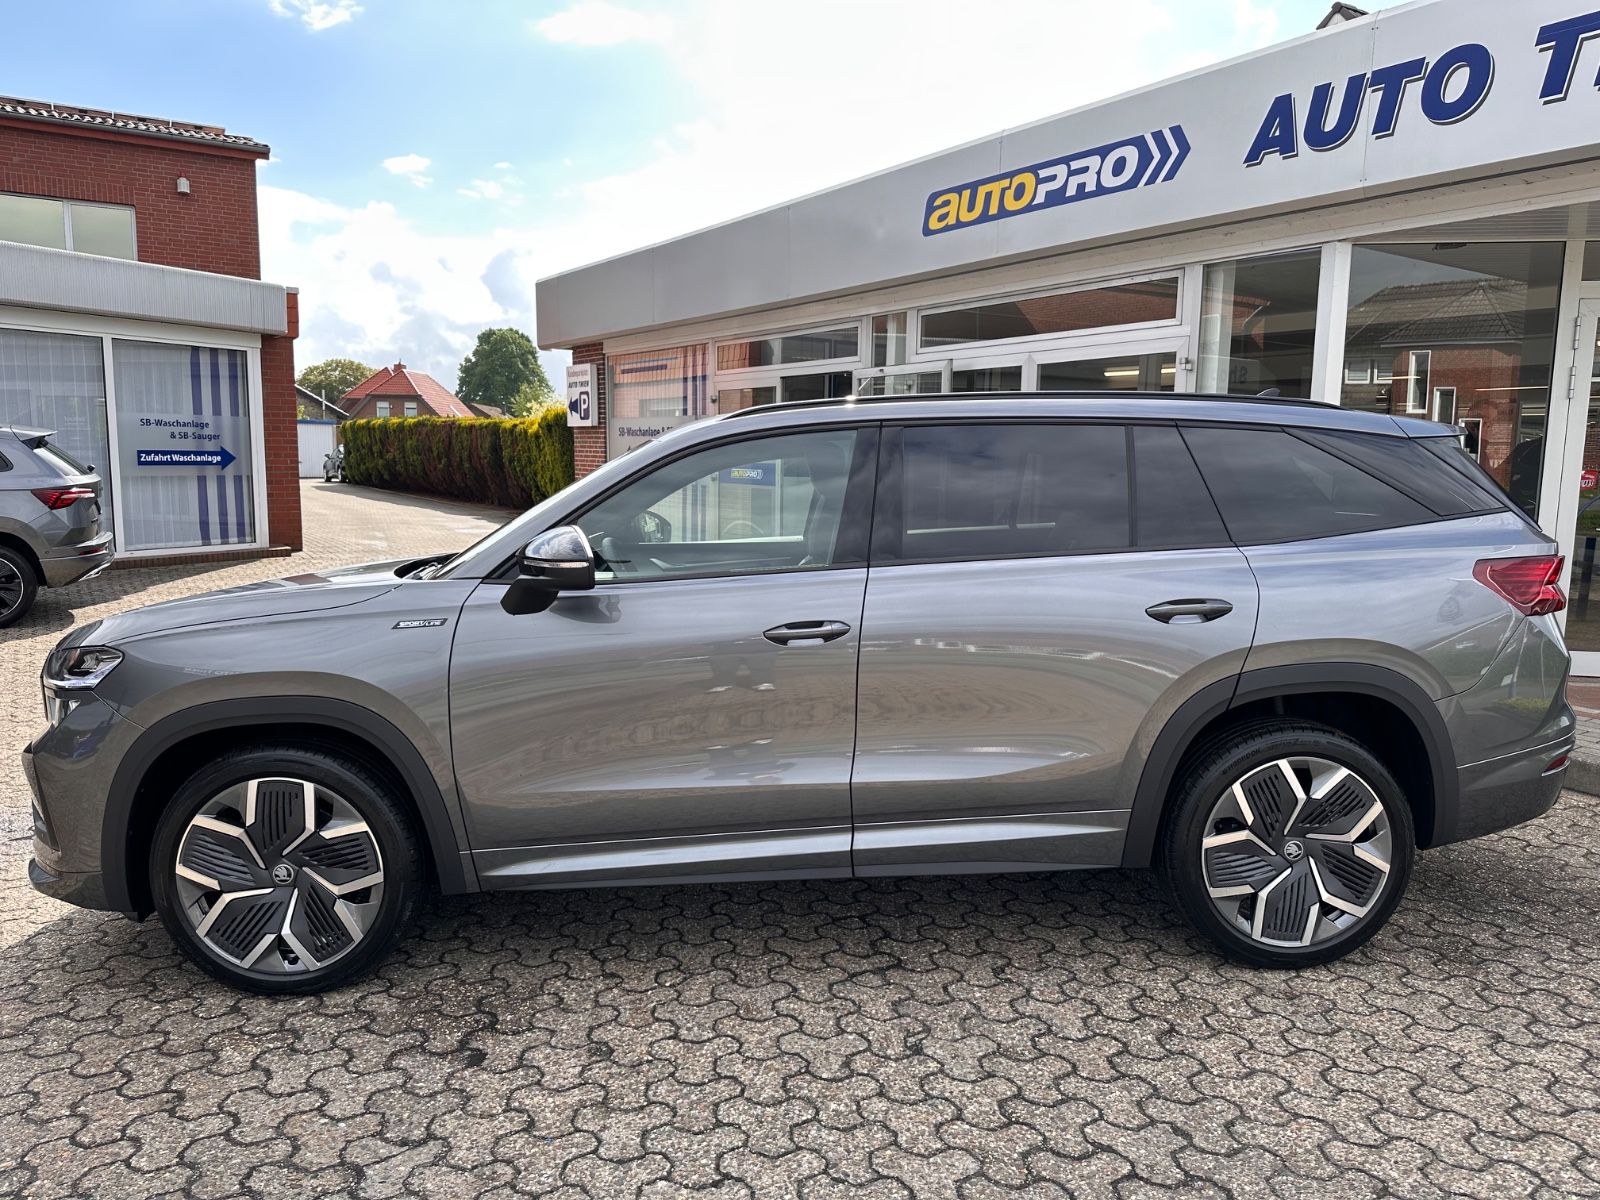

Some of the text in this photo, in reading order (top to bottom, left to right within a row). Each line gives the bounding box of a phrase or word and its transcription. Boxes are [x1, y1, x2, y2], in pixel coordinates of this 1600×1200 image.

[1243, 10, 1600, 167] AUTO T
[580, 393, 589, 418] P
[140, 418, 210, 430] SB-Waschanlage
[169, 431, 221, 442] & SB-Sauger
[139, 453, 222, 464] Zufahrt Waschanlage
